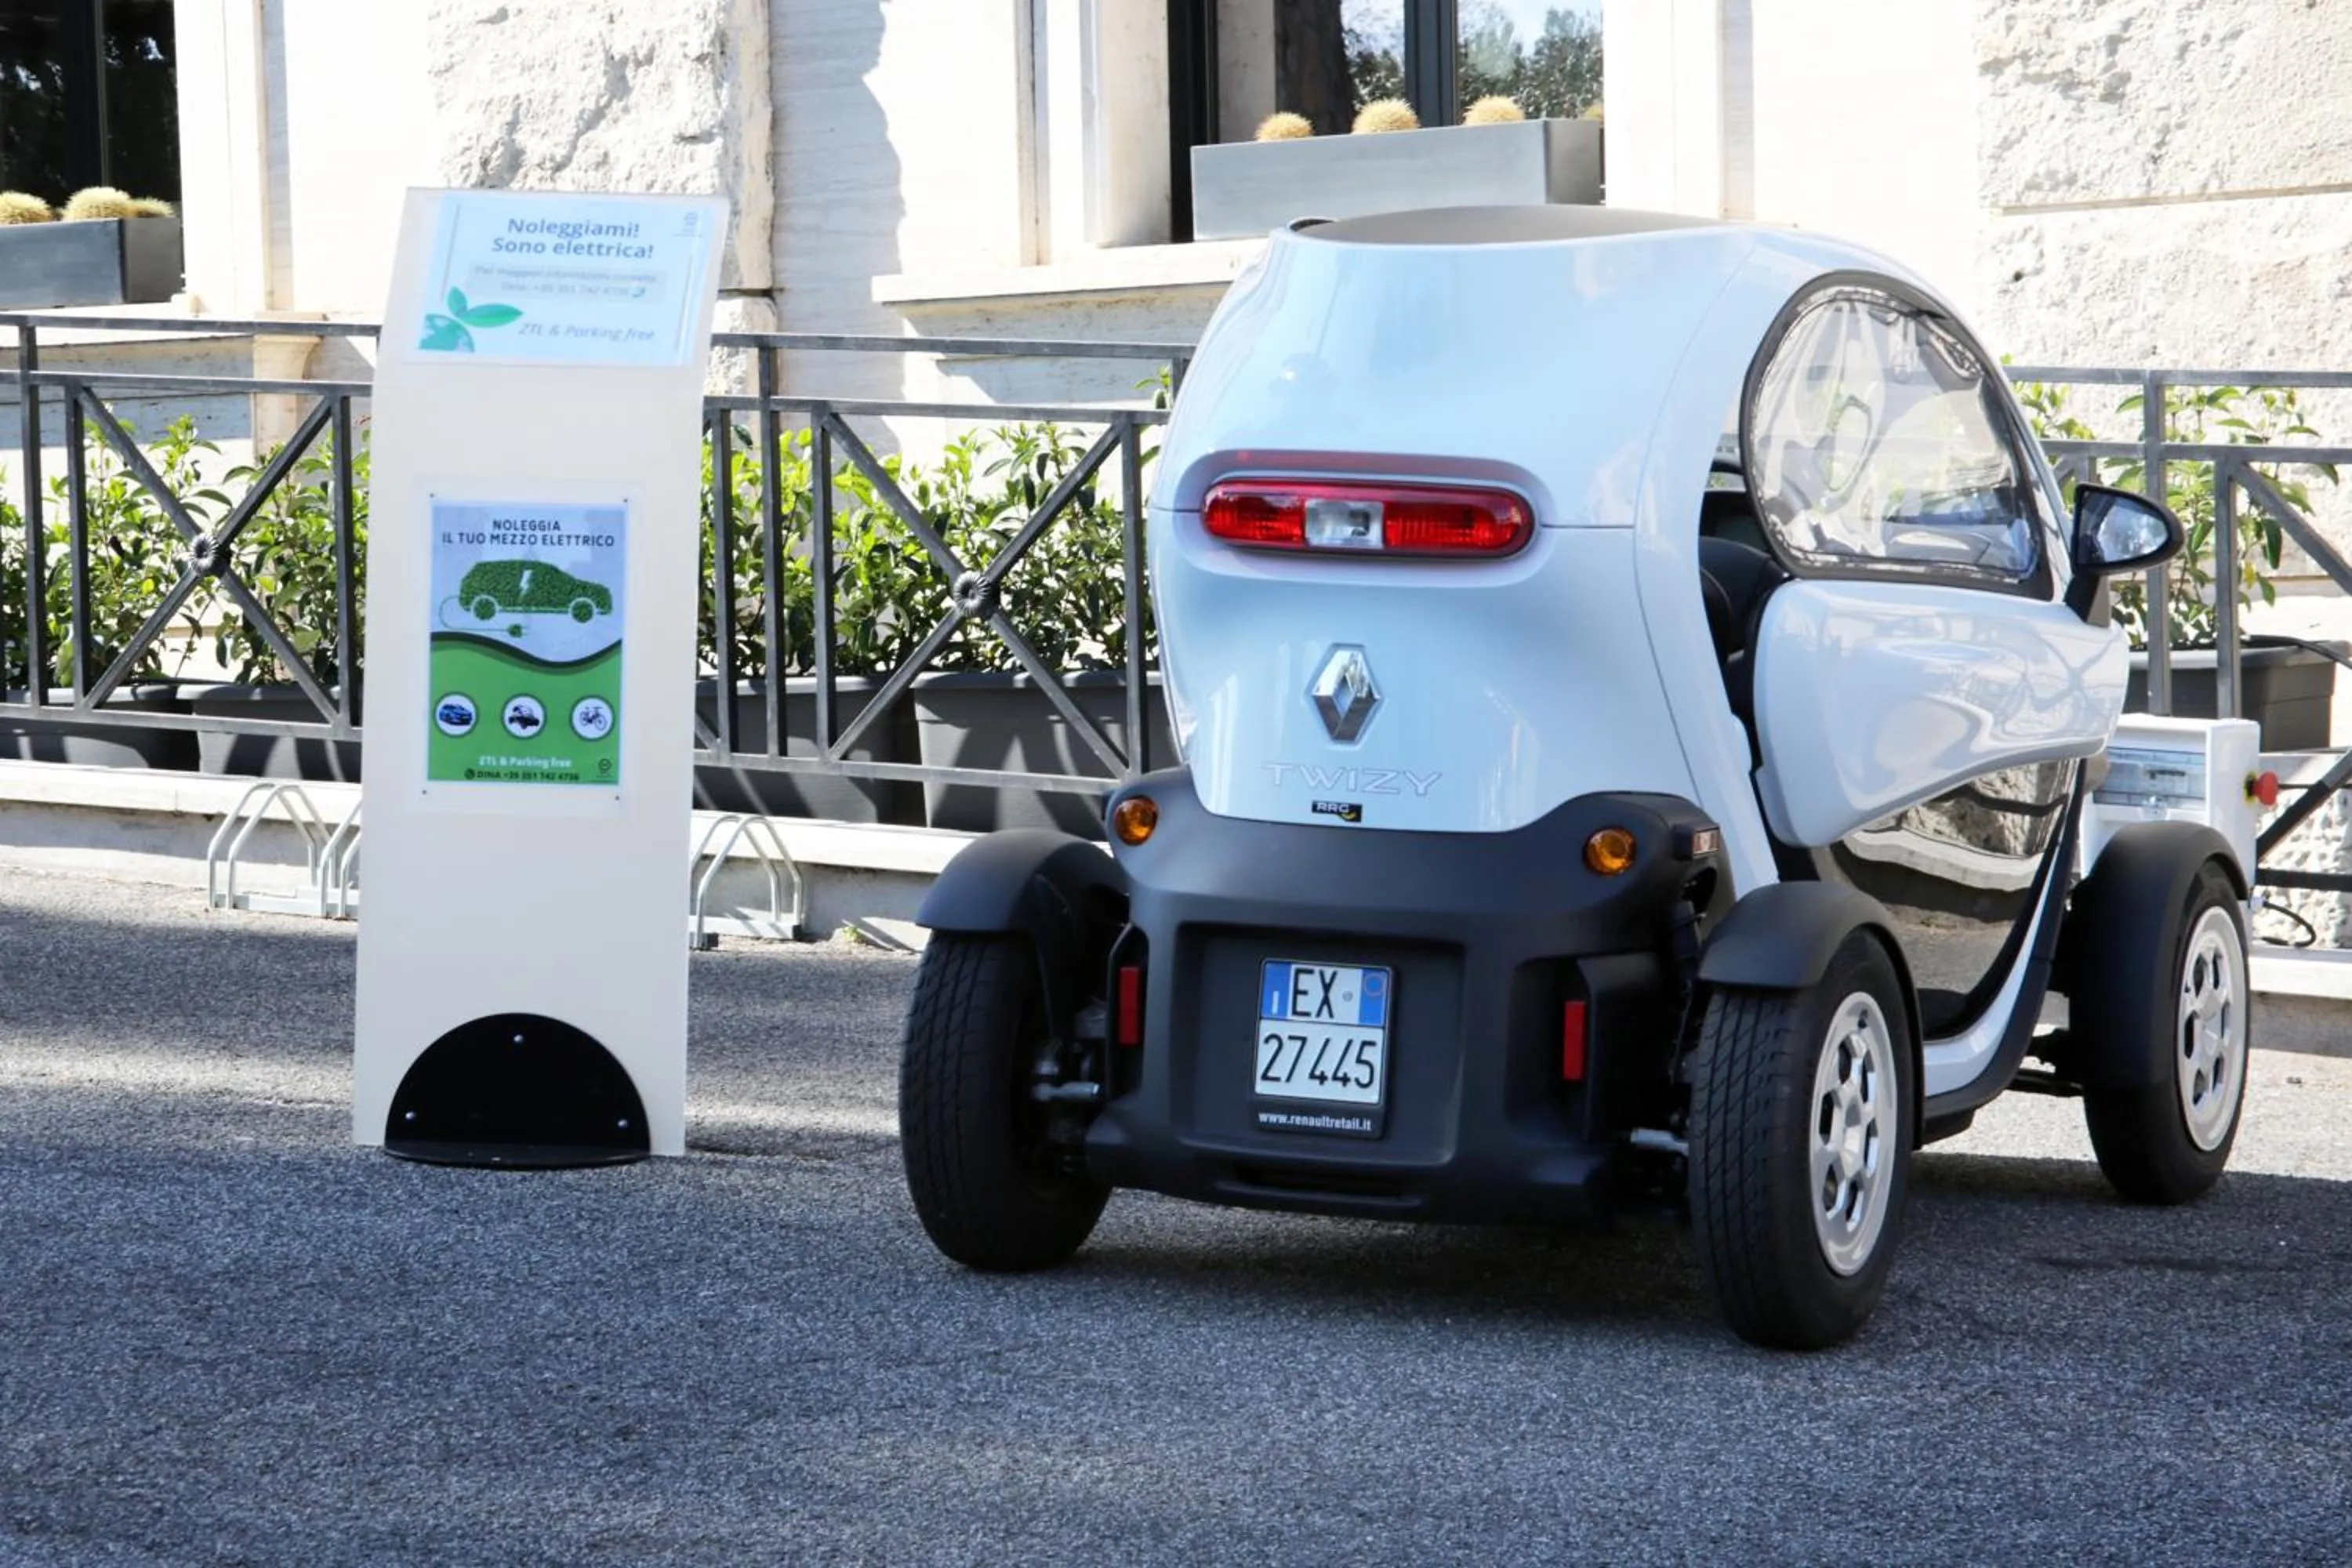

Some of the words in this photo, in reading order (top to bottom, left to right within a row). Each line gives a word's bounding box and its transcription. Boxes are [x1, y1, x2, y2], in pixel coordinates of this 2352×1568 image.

[508, 218, 640, 239] Noleggiami!
[492, 238, 546, 254] Sono
[552, 240, 654, 259] elettrica!
[518, 323, 543, 336] ZTL
[549, 325, 561, 337] &
[563, 325, 624, 342] Parking
[623, 327, 655, 343] free
[492, 518, 561, 532] NOLEGGIA
[442, 532, 452, 543] IL
[458, 532, 486, 544] TUO
[490, 533, 538, 546] MEZZO
[542, 535, 615, 547] ELETTRICO
[510, 756, 550, 769] Parking
[1262, 762, 1443, 796] TWIZY
[1316, 802, 1350, 813] RRG
[1292, 967, 1338, 1019] EX
[1260, 1033, 1377, 1090] 27445
[1258, 1112, 1372, 1131] www.renaultretail.it
